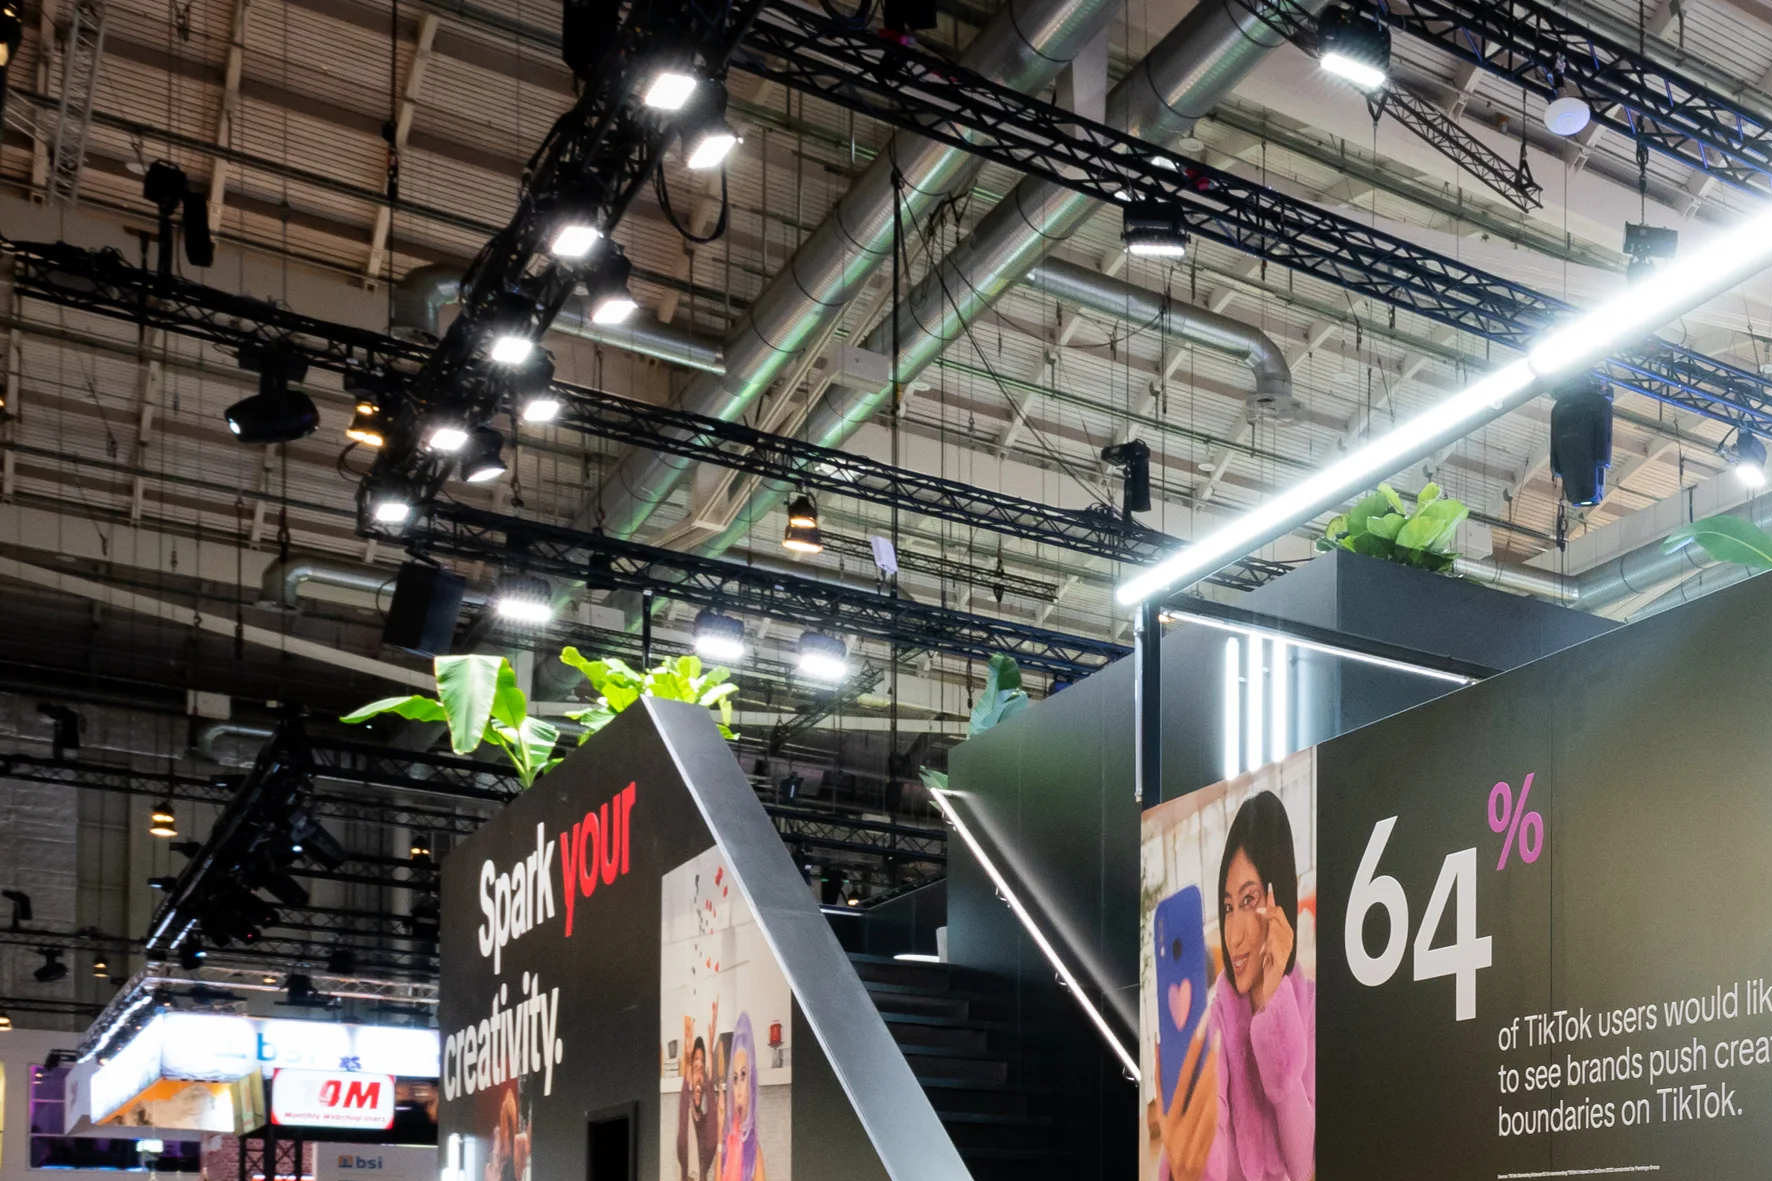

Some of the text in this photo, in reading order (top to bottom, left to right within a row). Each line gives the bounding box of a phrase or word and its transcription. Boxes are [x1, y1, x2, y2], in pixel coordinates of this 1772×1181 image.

[478, 781, 637, 975] Spark your
[443, 971, 563, 1102] creativity.
[1498, 1017, 1520, 1051] of
[1524, 1007, 1593, 1047] TikTok
[1598, 1004, 1658, 1037] users
[1663, 982, 1739, 1027] would
[1497, 1064, 1520, 1094] to
[1524, 1063, 1562, 1091] see
[1567, 1046, 1643, 1086] brands
[1649, 1037, 1707, 1086] push
[1498, 1081, 1743, 1137] boundaries on TikTok.
[356, 1156, 383, 1169] bsi
